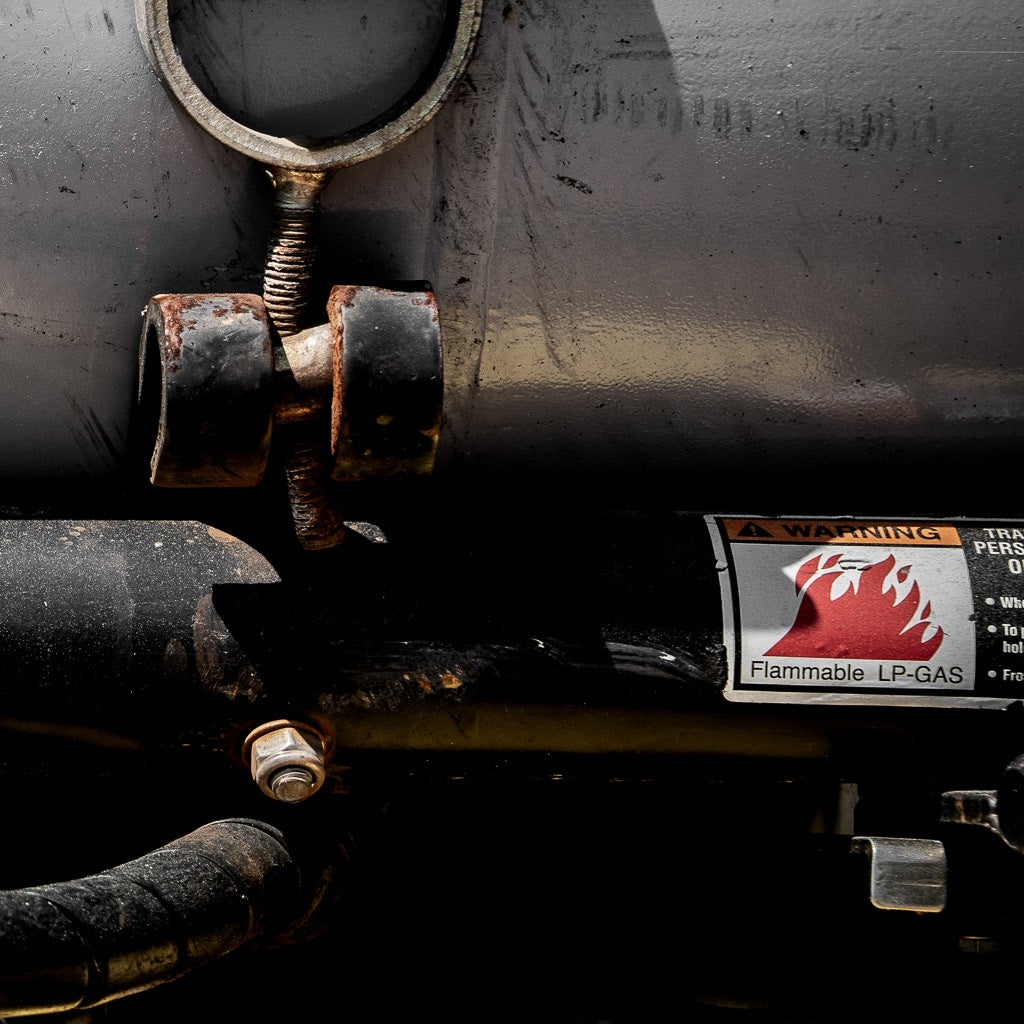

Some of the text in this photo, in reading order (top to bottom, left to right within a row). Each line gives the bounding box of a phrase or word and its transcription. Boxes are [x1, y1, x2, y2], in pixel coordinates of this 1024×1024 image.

[782, 525, 942, 541] WARNING
[1002, 623, 1018, 637] To
[750, 660, 964, 684] Flammable LP-GAS
